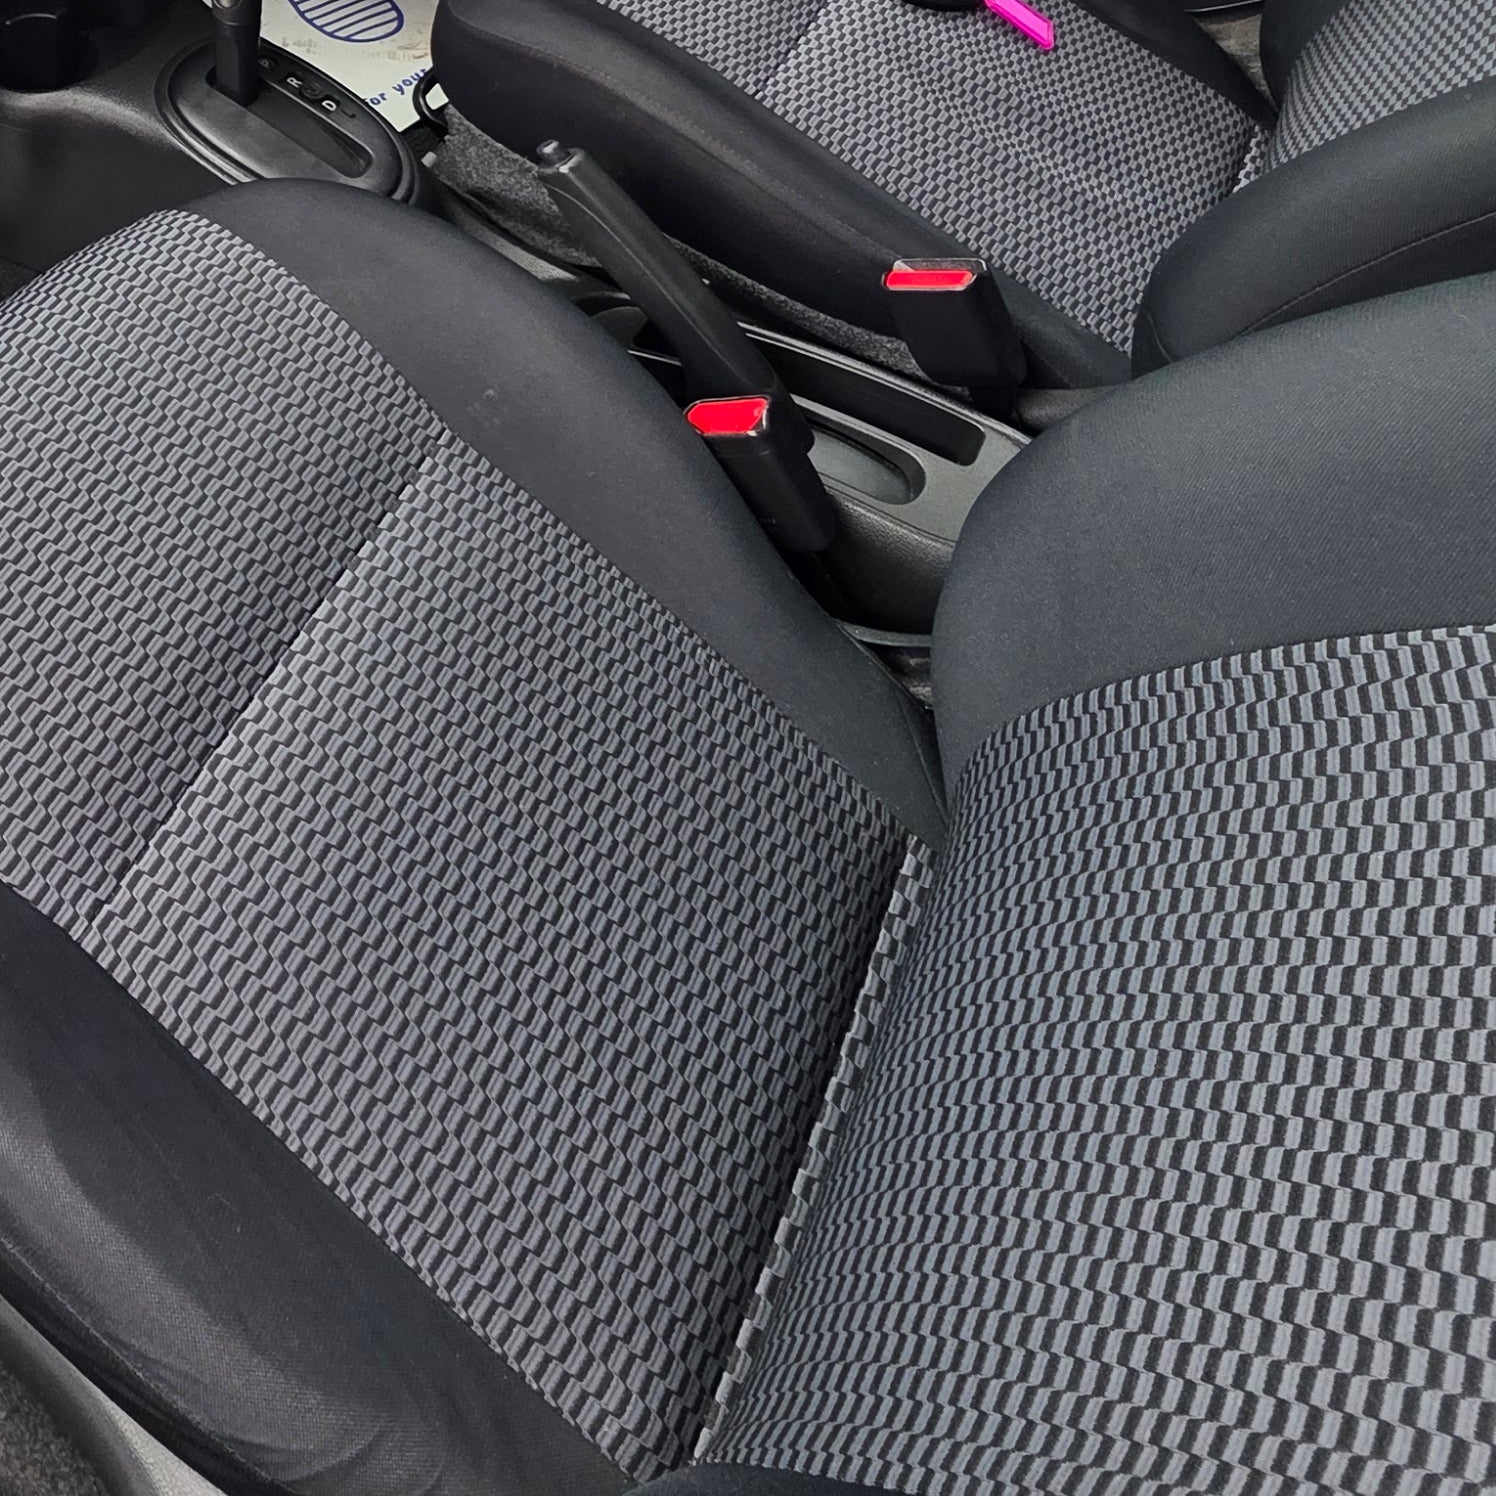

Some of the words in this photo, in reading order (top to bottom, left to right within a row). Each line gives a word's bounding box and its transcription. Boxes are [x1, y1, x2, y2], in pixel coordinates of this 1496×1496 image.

[286, 76, 303, 89] R
[321, 99, 337, 112] D
[364, 92, 387, 106] or
